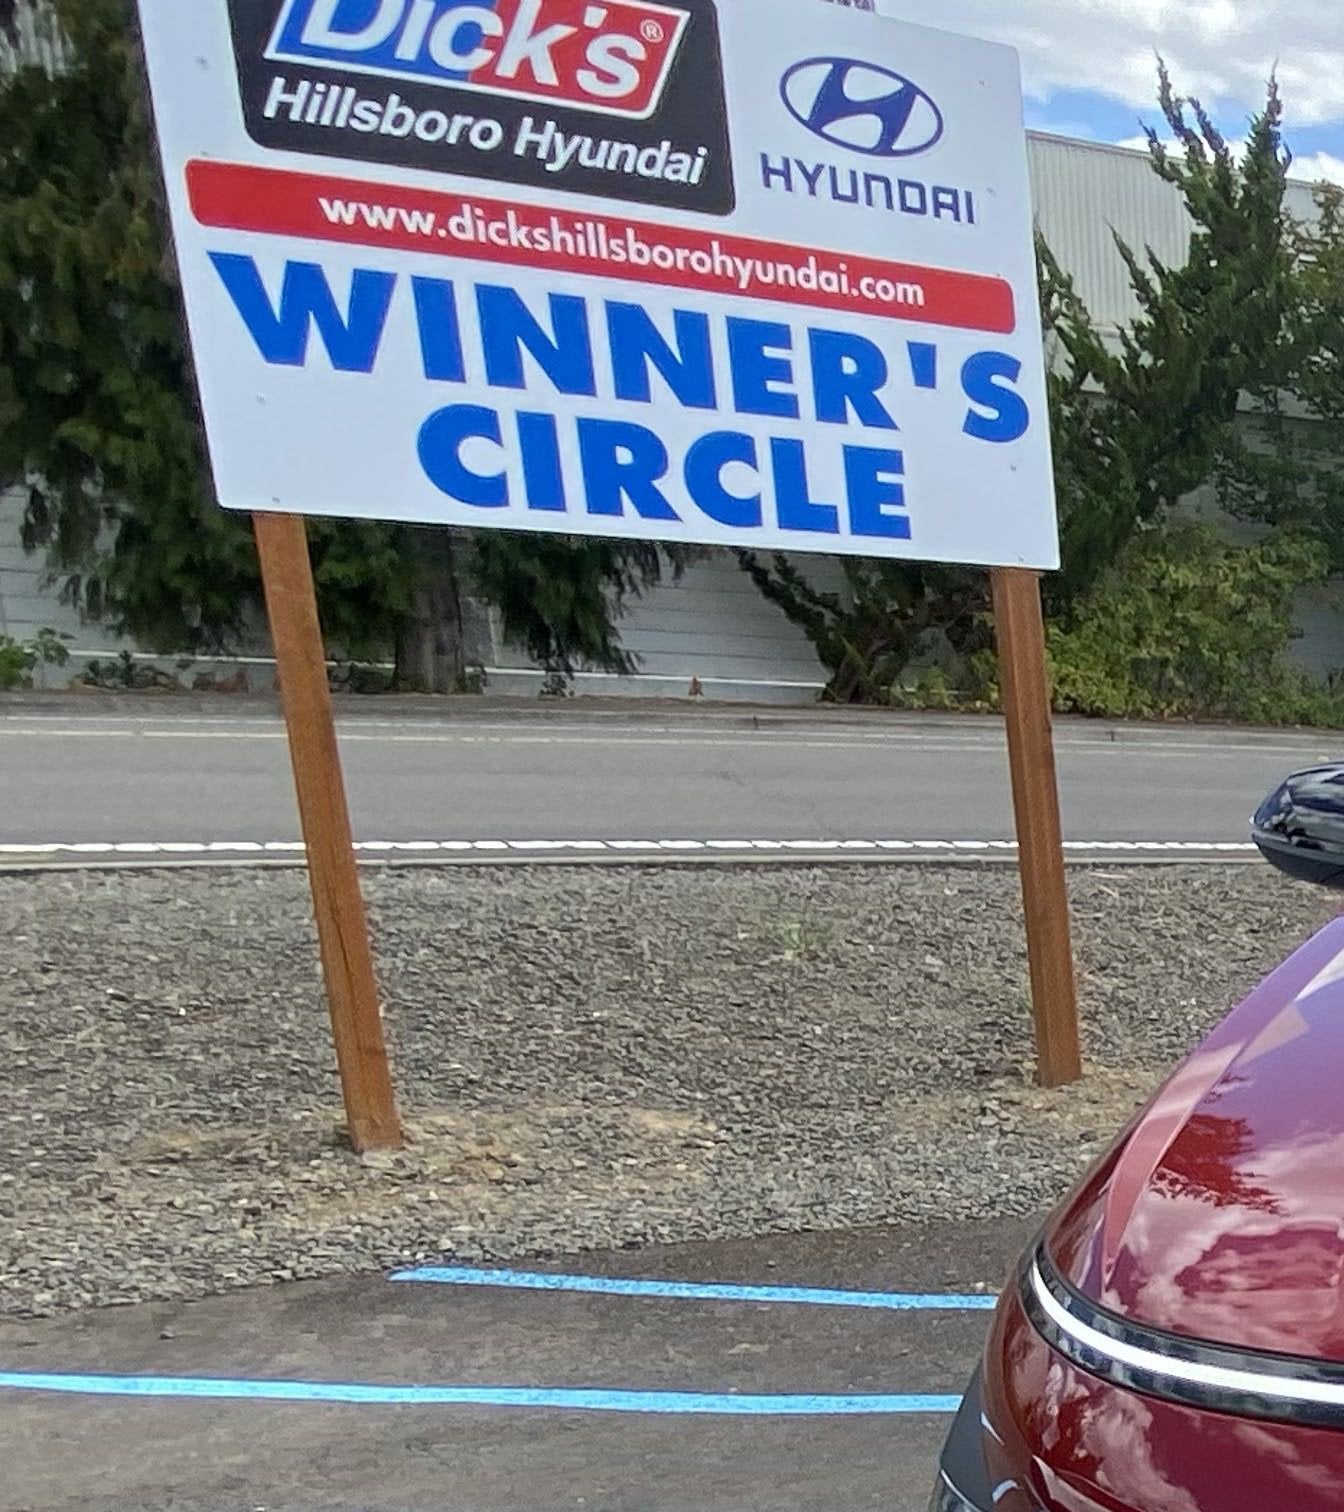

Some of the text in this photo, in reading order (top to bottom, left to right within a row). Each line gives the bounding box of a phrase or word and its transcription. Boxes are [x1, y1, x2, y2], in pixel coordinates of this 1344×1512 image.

[262, 76, 710, 186] Hillsboro Hyundai
[759, 152, 977, 225] HYUNDAI
[318, 196, 926, 308] www.dickshillsborohyundai.com
[206, 250, 1030, 443] WINNER'S
[416, 402, 912, 541] CIRCLE
